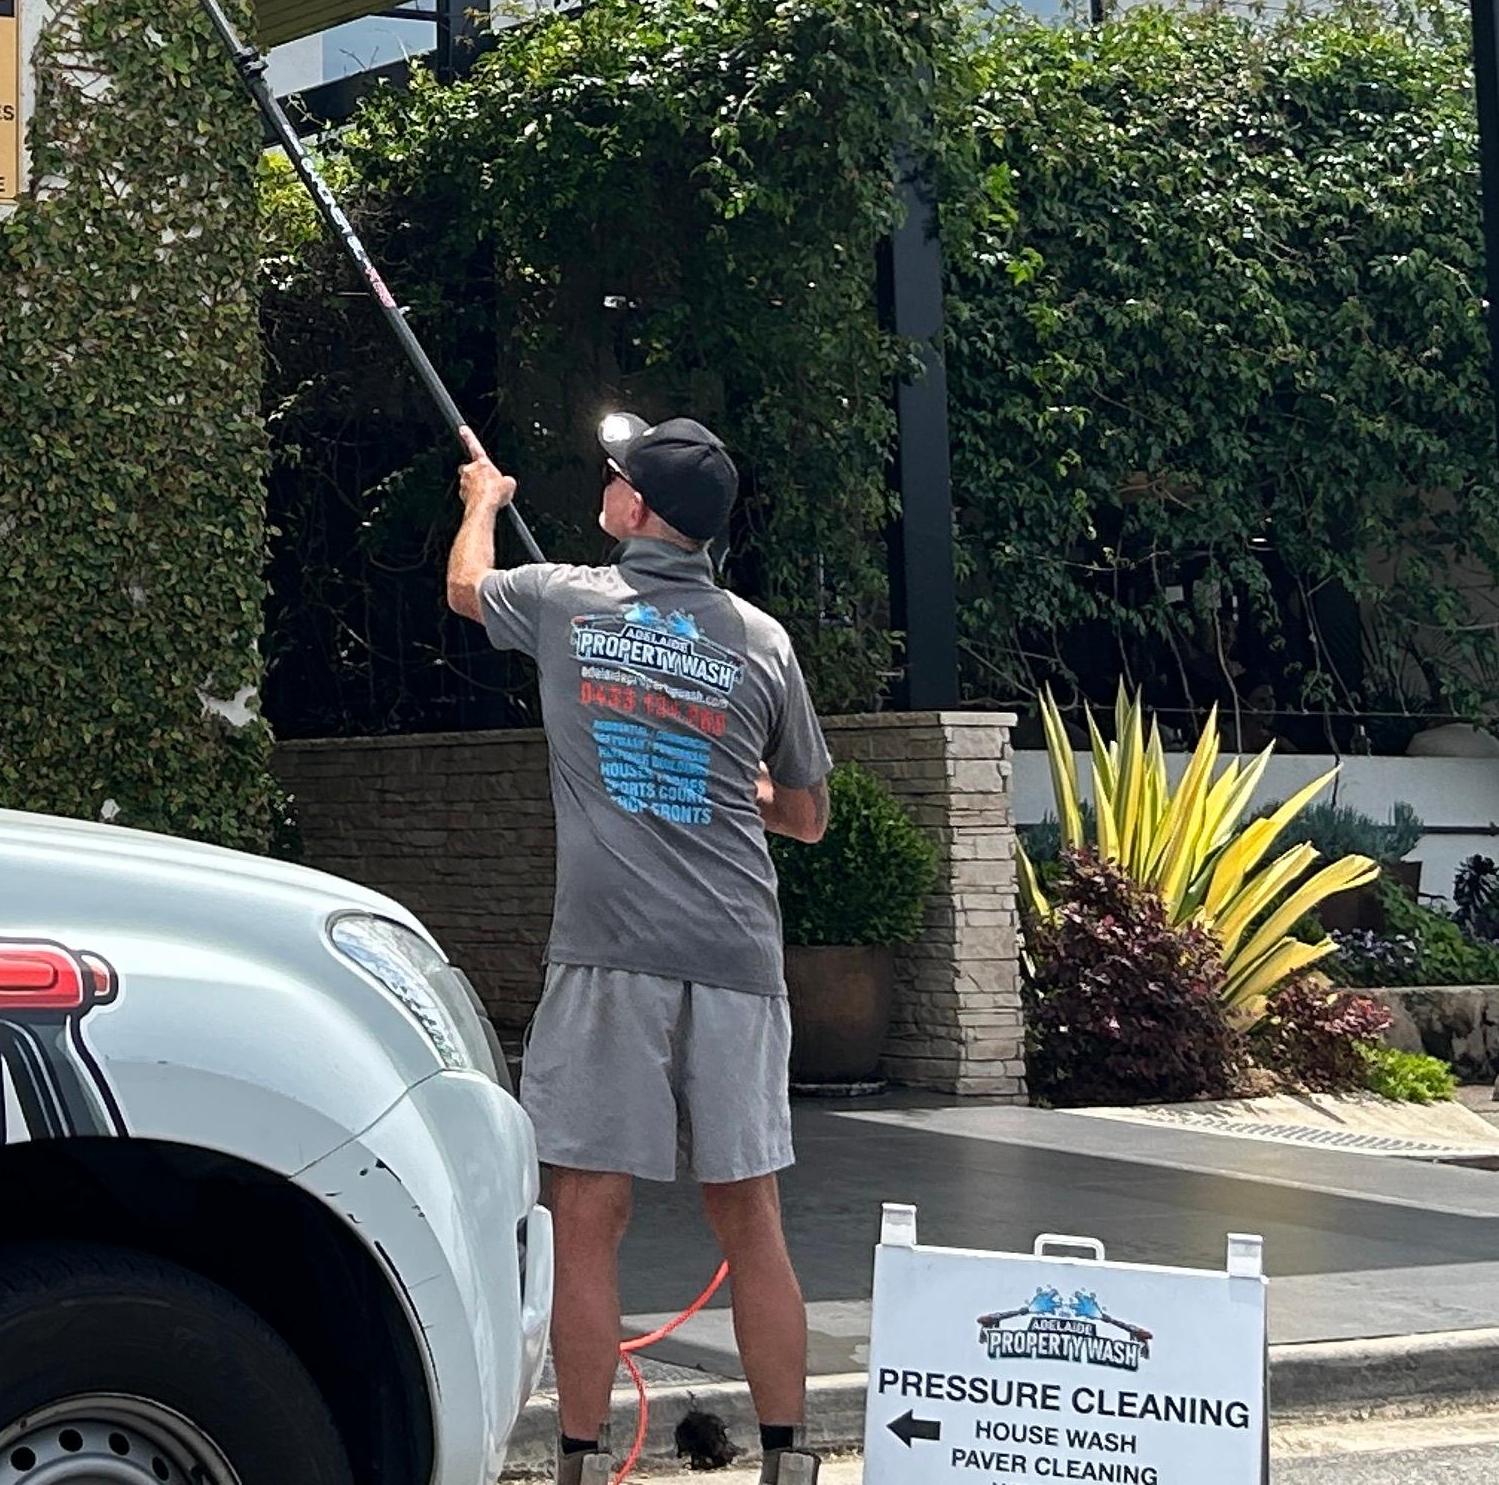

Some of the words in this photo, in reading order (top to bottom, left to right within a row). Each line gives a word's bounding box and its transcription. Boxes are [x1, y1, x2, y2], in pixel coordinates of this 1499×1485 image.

[625, 627, 689, 652] ADELAIDE
[580, 632, 678, 669] PROPERTY
[681, 654, 731, 688] WASH
[1031, 1319, 1094, 1336] ADELAIDE
[989, 1331, 1085, 1358] PROPERTY
[1086, 1337, 1138, 1368] WASH
[878, 1368, 1061, 1410] PRESSURE
[1072, 1388, 1250, 1429] CLEANING
[975, 1419, 1060, 1446] HOUSE
[1066, 1427, 1137, 1454] WASH
[951, 1448, 1027, 1474] PAVER
[1034, 1456, 1158, 1485] CLEANING
